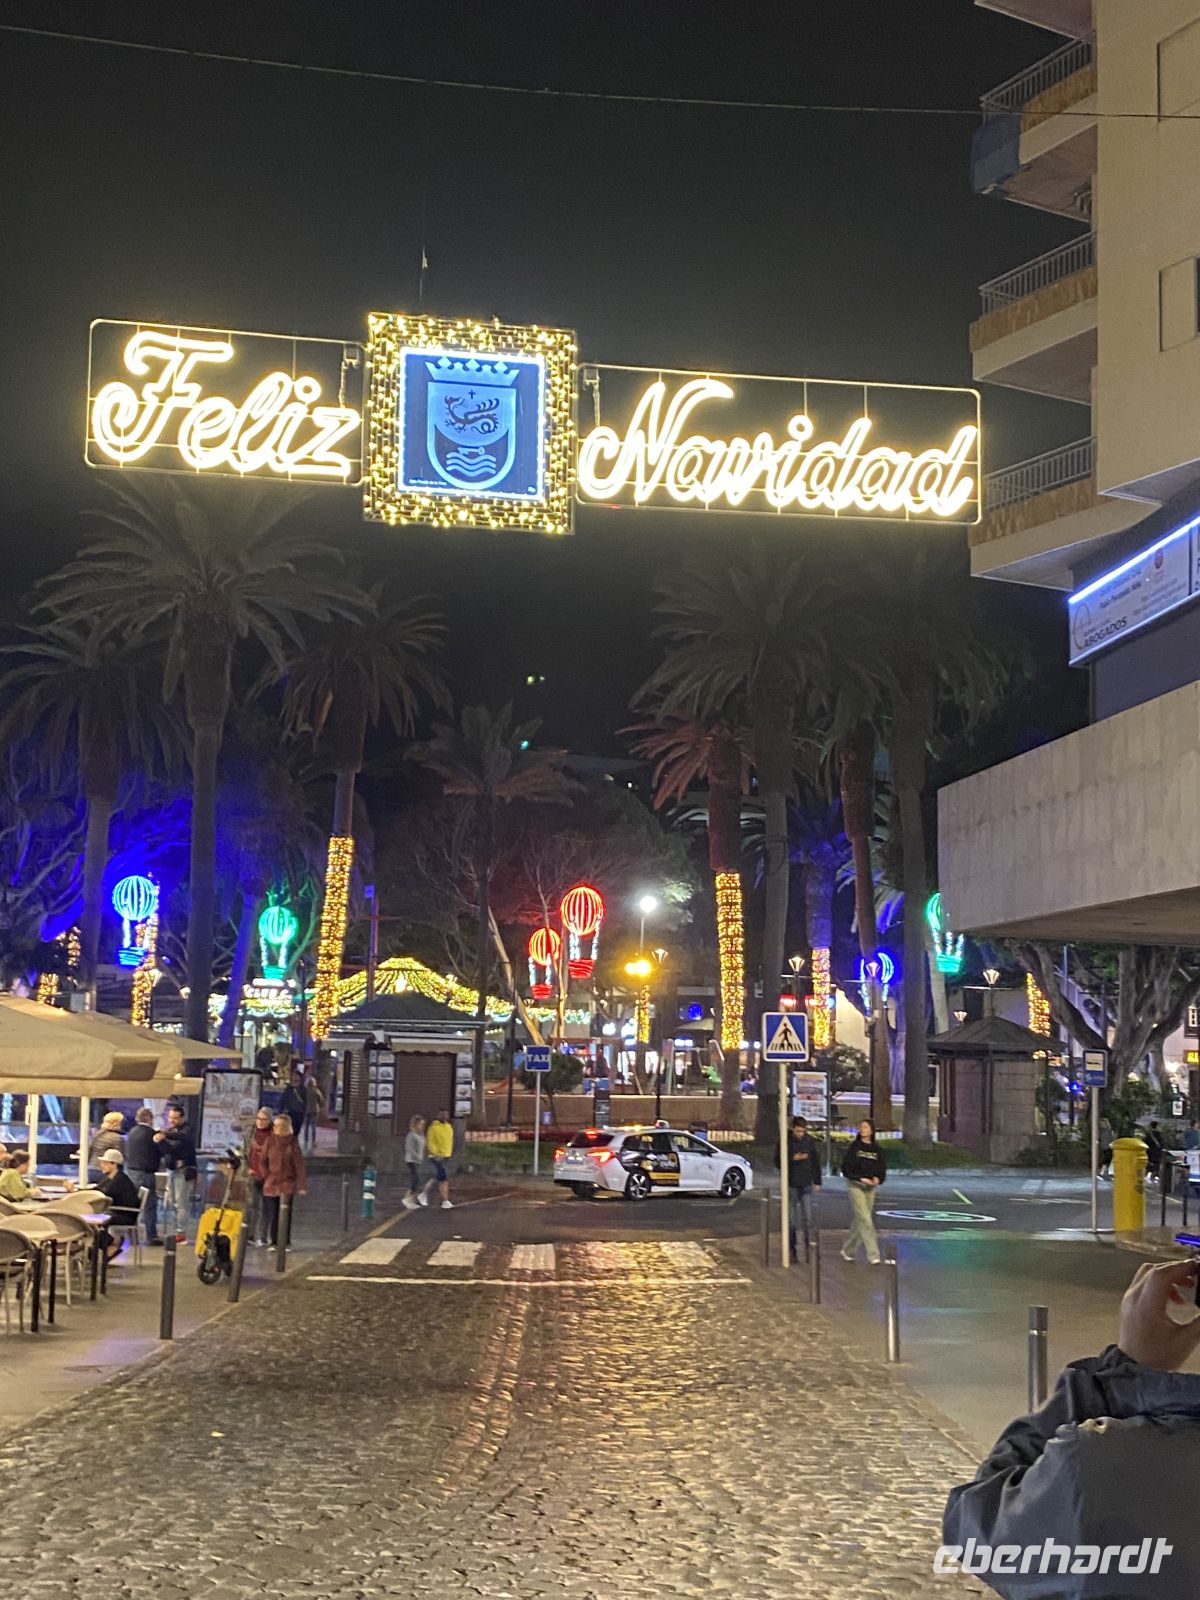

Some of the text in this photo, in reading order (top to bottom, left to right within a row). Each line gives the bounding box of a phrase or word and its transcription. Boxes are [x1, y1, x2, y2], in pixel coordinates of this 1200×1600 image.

[91, 330, 979, 516] Feliz Navidad
[1084, 616, 1127, 648] ABOGADOS
